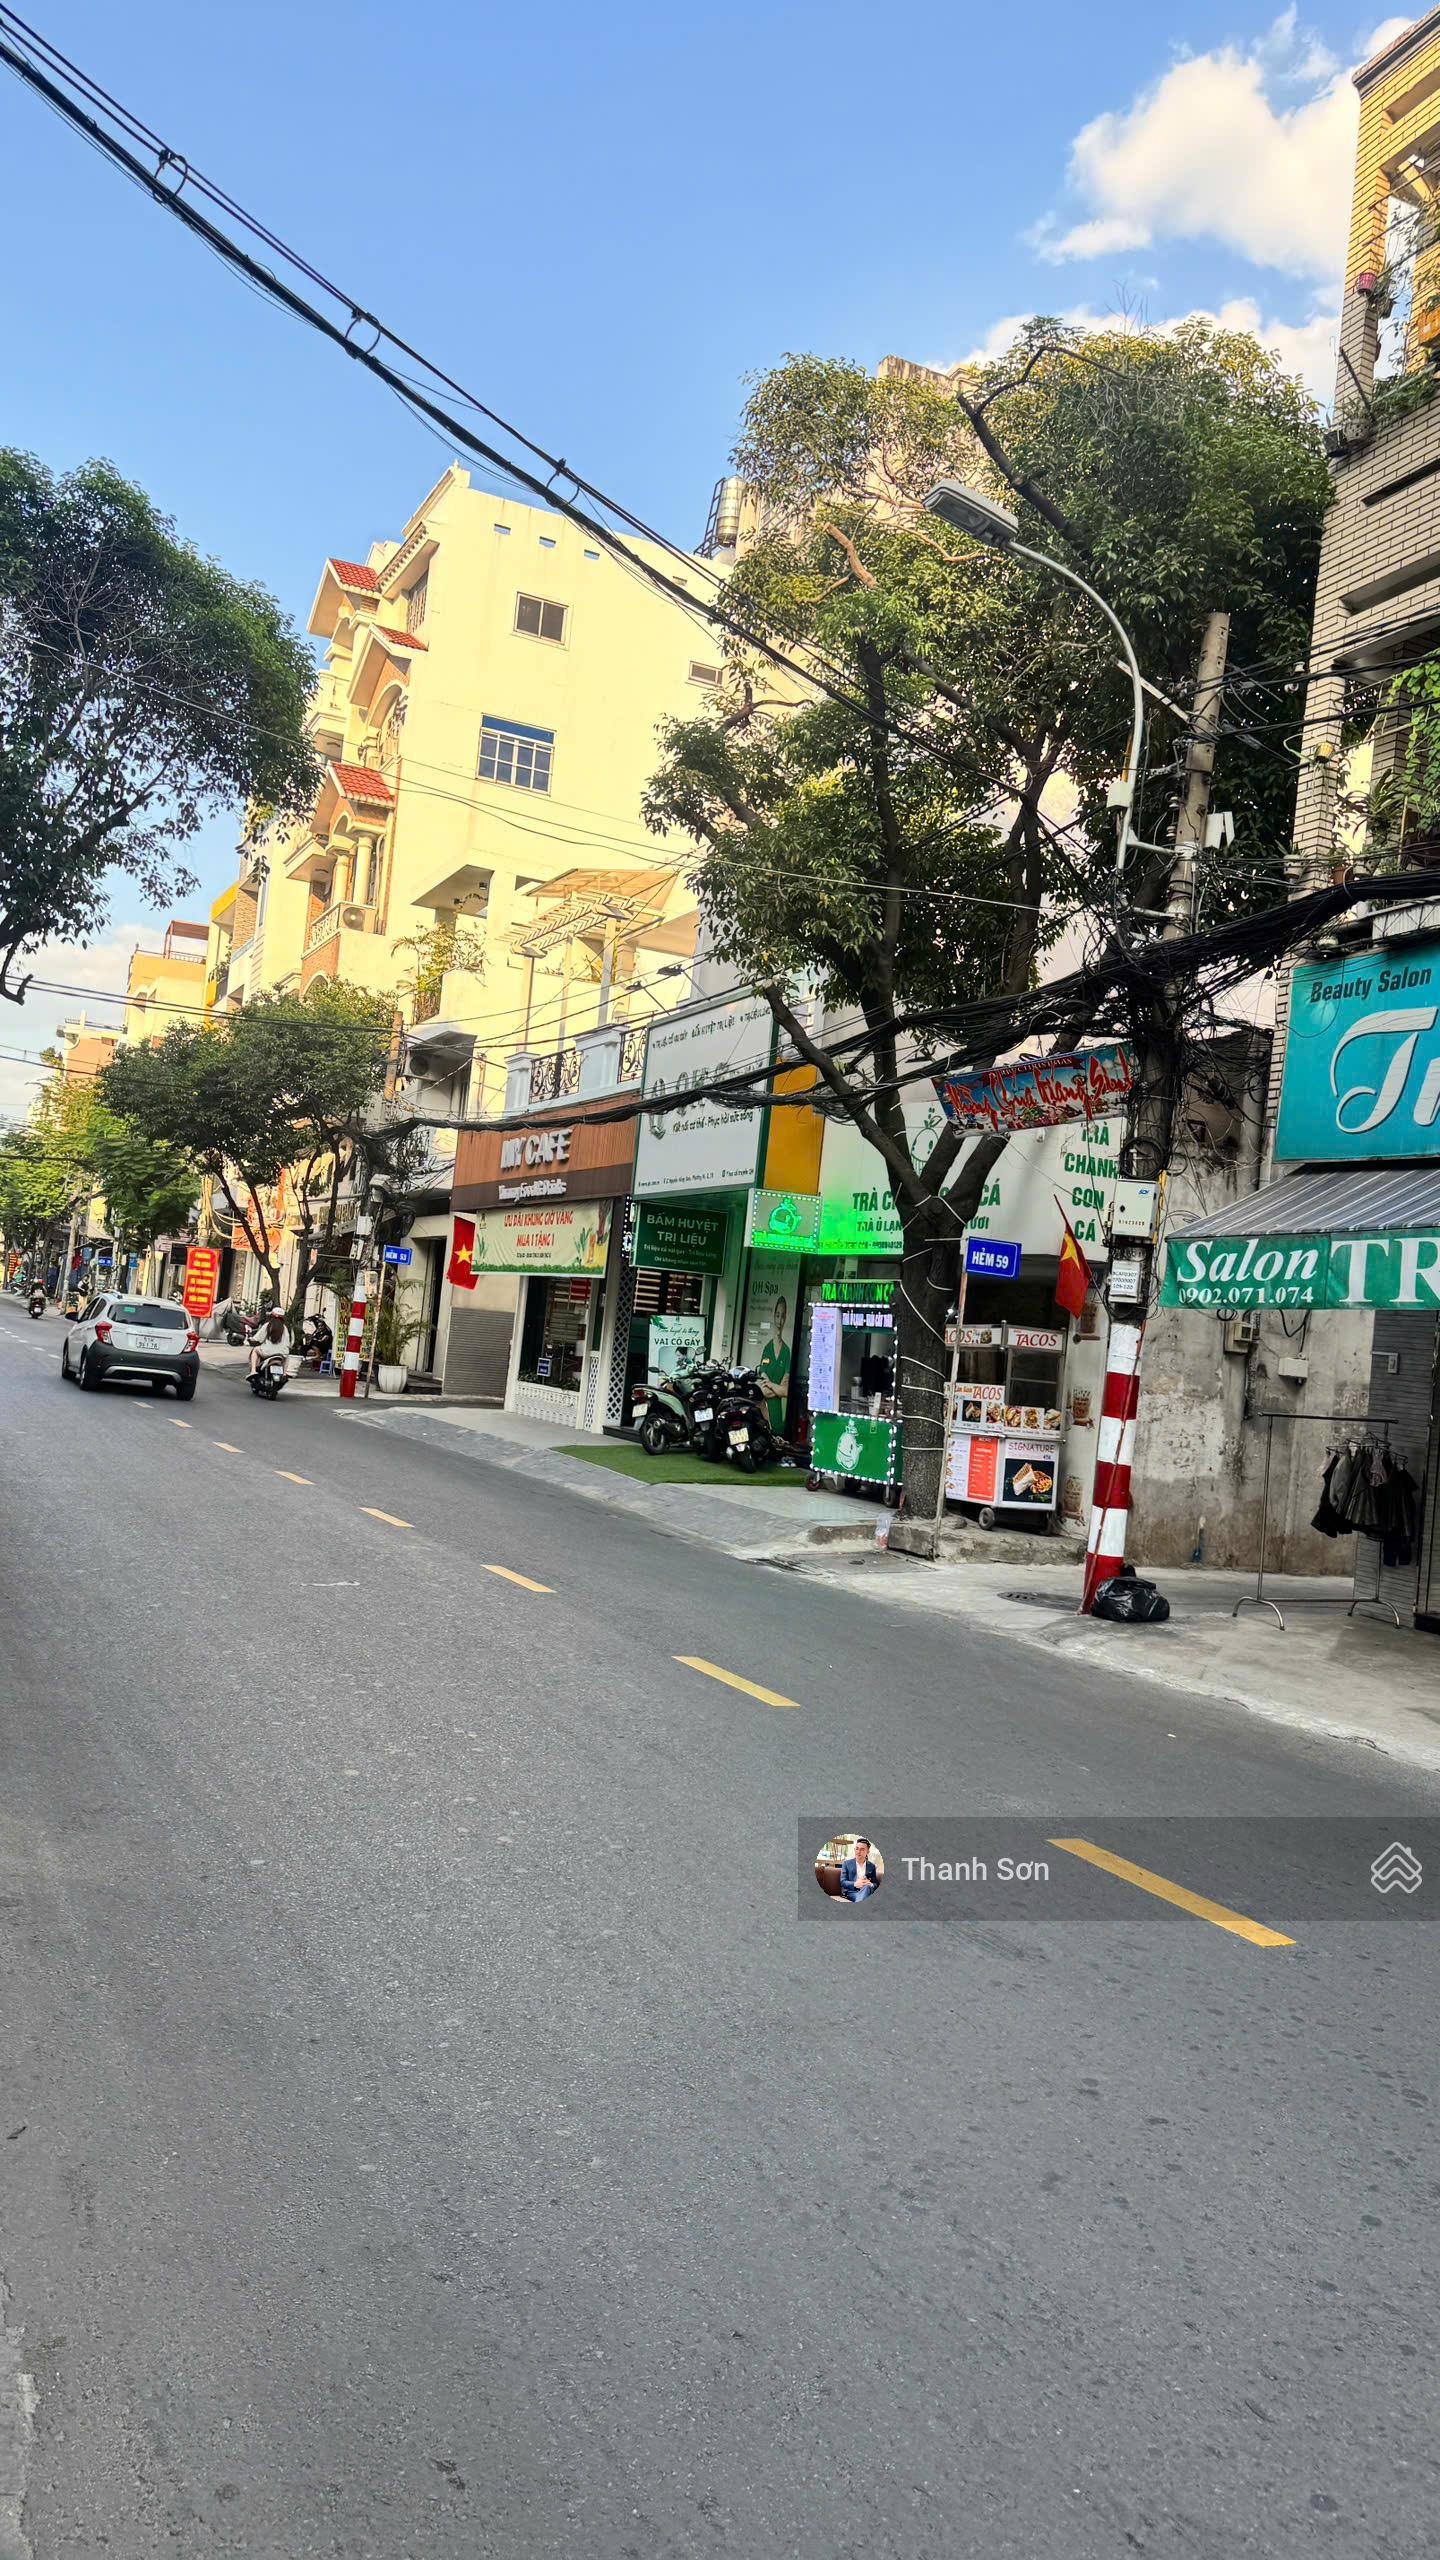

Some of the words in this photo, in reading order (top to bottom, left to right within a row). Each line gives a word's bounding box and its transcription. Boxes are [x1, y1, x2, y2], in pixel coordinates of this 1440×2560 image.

[1310, 977, 1373, 1003] Beauty
[1377, 966, 1433, 993] Salon
[525, 1128, 573, 1166] CAFE
[1063, 1152, 1118, 1179] CHANH
[852, 1187, 879, 1212] TRÀ
[1071, 1186, 1105, 1210] CON
[646, 1211, 675, 1227] BẤM
[677, 1218, 719, 1234] HUYỆT
[857, 1217, 873, 1232] TRÀ
[883, 1220, 903, 1235] LẠN
[1074, 1219, 1096, 1242] CÁ
[657, 1230, 677, 1246] TRỊ
[680, 1232, 707, 1248] LIỆU
[971, 1247, 995, 1266] HẺM
[995, 1255, 1009, 1269] 59
[1176, 1238, 1319, 1283] Salon
[764, 1281, 779, 1296] Spa
[1177, 1286, 1314, 1305] 0902.071.074
[945, 1329, 972, 1344] ACOS
[1015, 1332, 1058, 1347] TACOS
[972, 1385, 1003, 1401] TACOS
[1008, 1441, 1056, 1454] SIGNATURE
